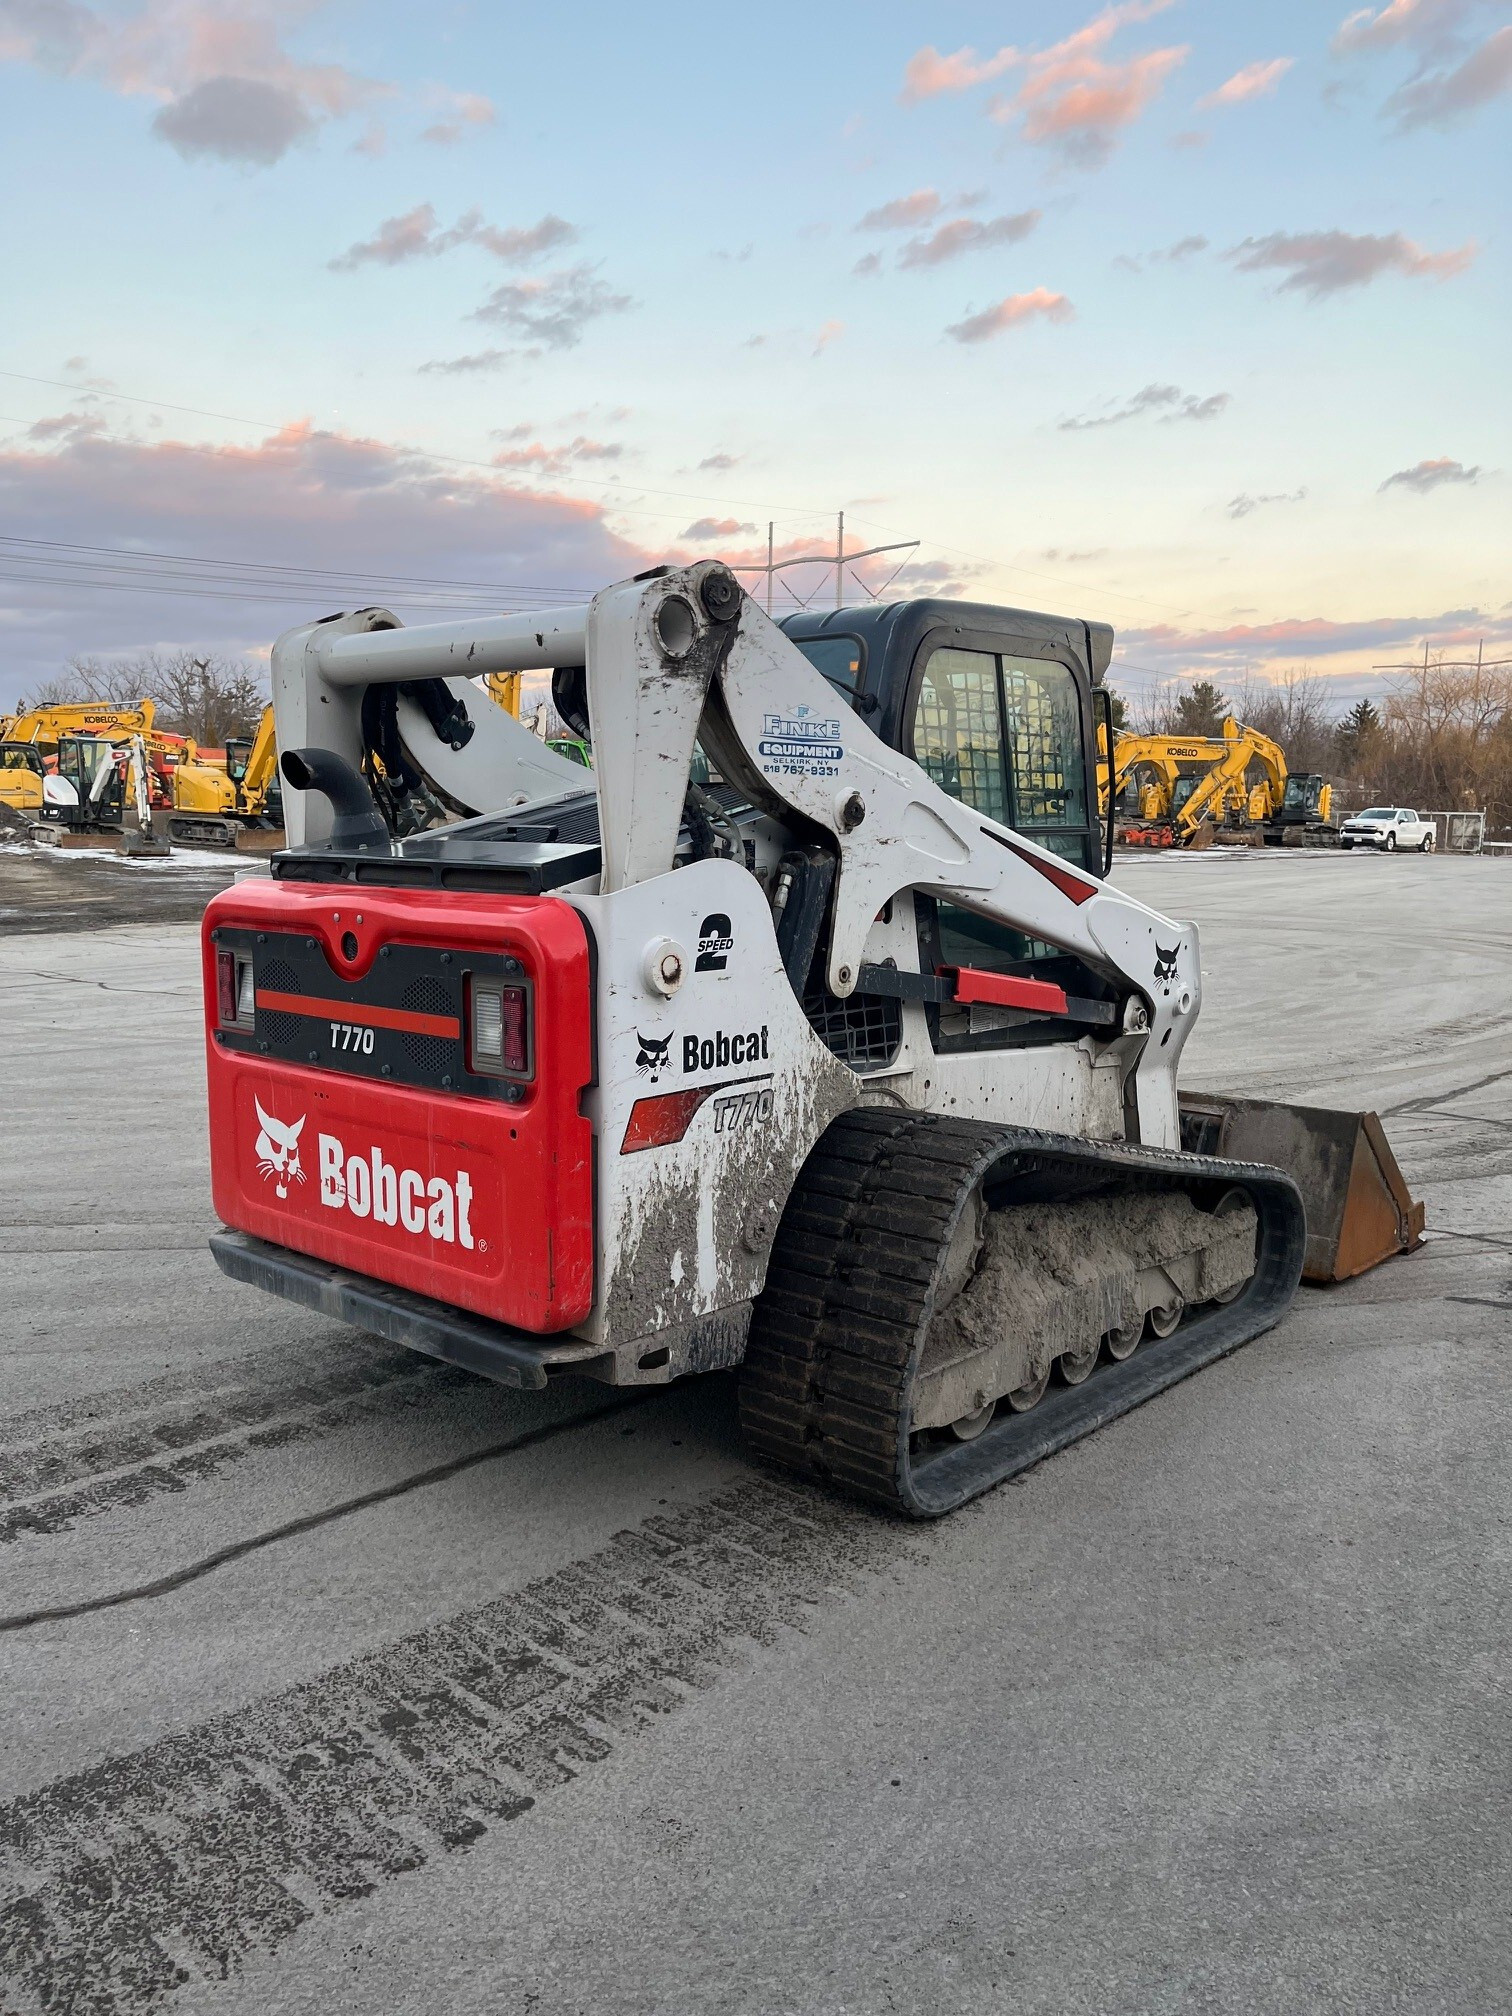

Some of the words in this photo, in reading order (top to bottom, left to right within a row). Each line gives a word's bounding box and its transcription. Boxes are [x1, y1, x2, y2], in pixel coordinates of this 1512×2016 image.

[84, 716, 118, 724] KOBELCO
[763, 714, 840, 739] FINKE
[763, 743, 839, 758] EQUIPMENT
[1167, 748, 1198, 757] KOBELCO
[764, 765, 780, 773] 518
[782, 765, 839, 776] 767-9331
[695, 912, 732, 972] 2
[697, 938, 733, 952] SPEED
[330, 1023, 375, 1054] T770
[682, 1025, 769, 1074] Bobcat
[713, 1088, 774, 1133] T770
[318, 1133, 474, 1249] Bobcat
